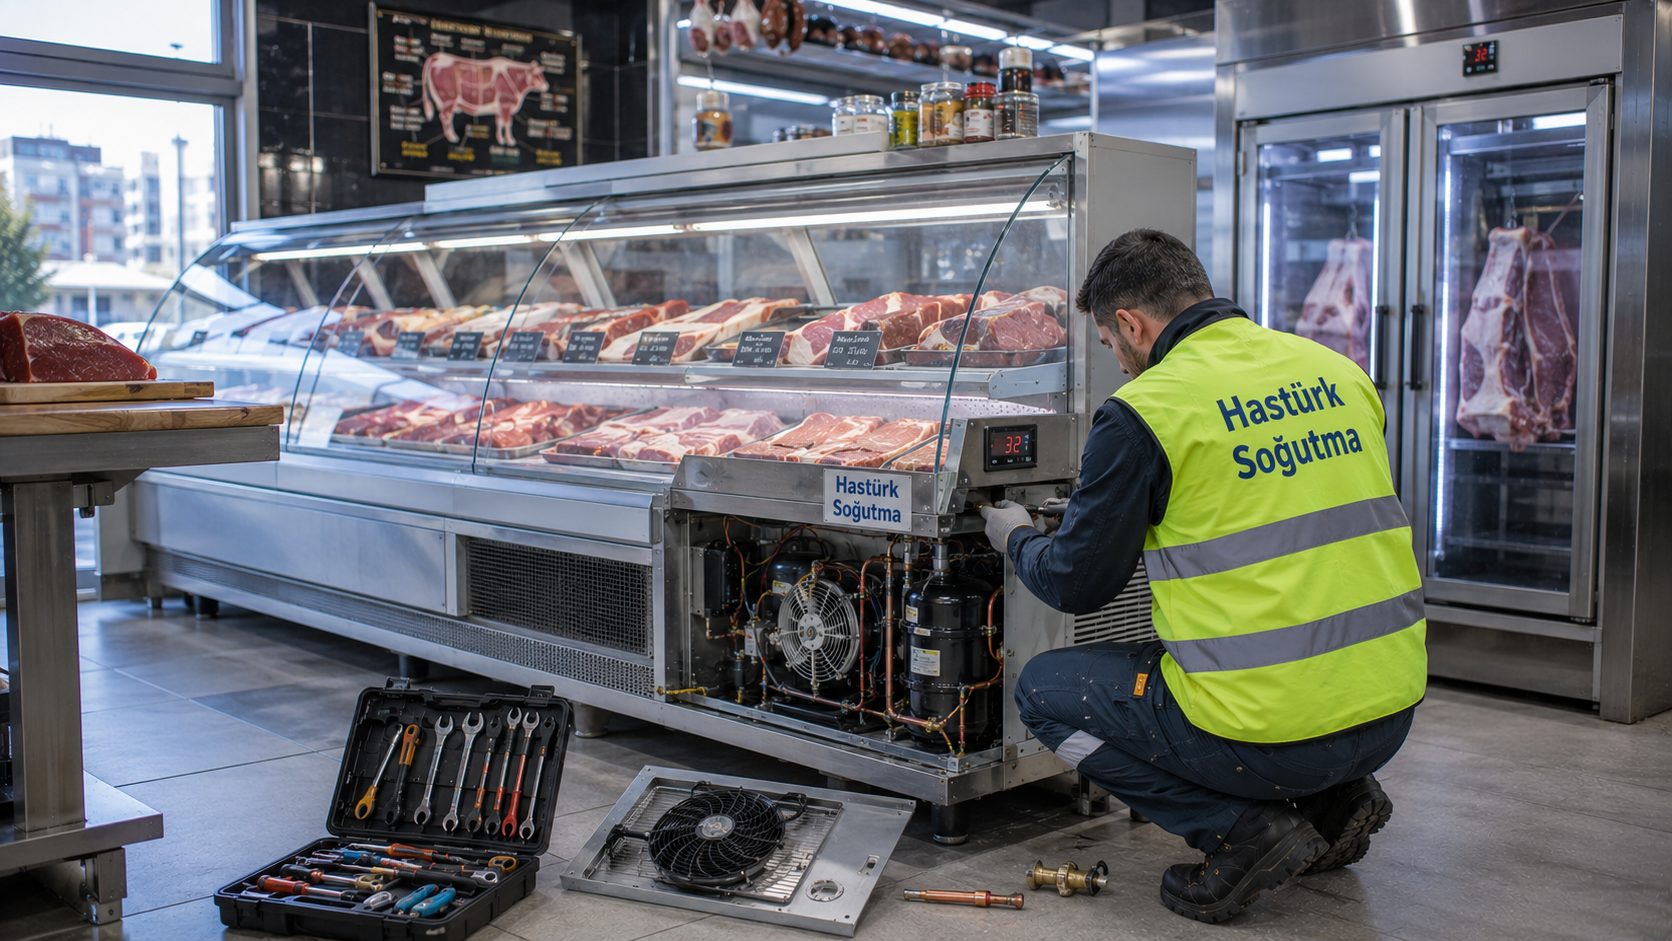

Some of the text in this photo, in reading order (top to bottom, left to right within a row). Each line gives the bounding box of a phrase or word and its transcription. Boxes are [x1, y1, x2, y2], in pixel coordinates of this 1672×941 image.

[1216, 376, 1345, 432] Hastürk
[1005, 435, 1022, 454] 32
[1232, 428, 1363, 480] Soğutma
[836, 475, 899, 498] Hastürk
[833, 498, 901, 523] Soğutma
